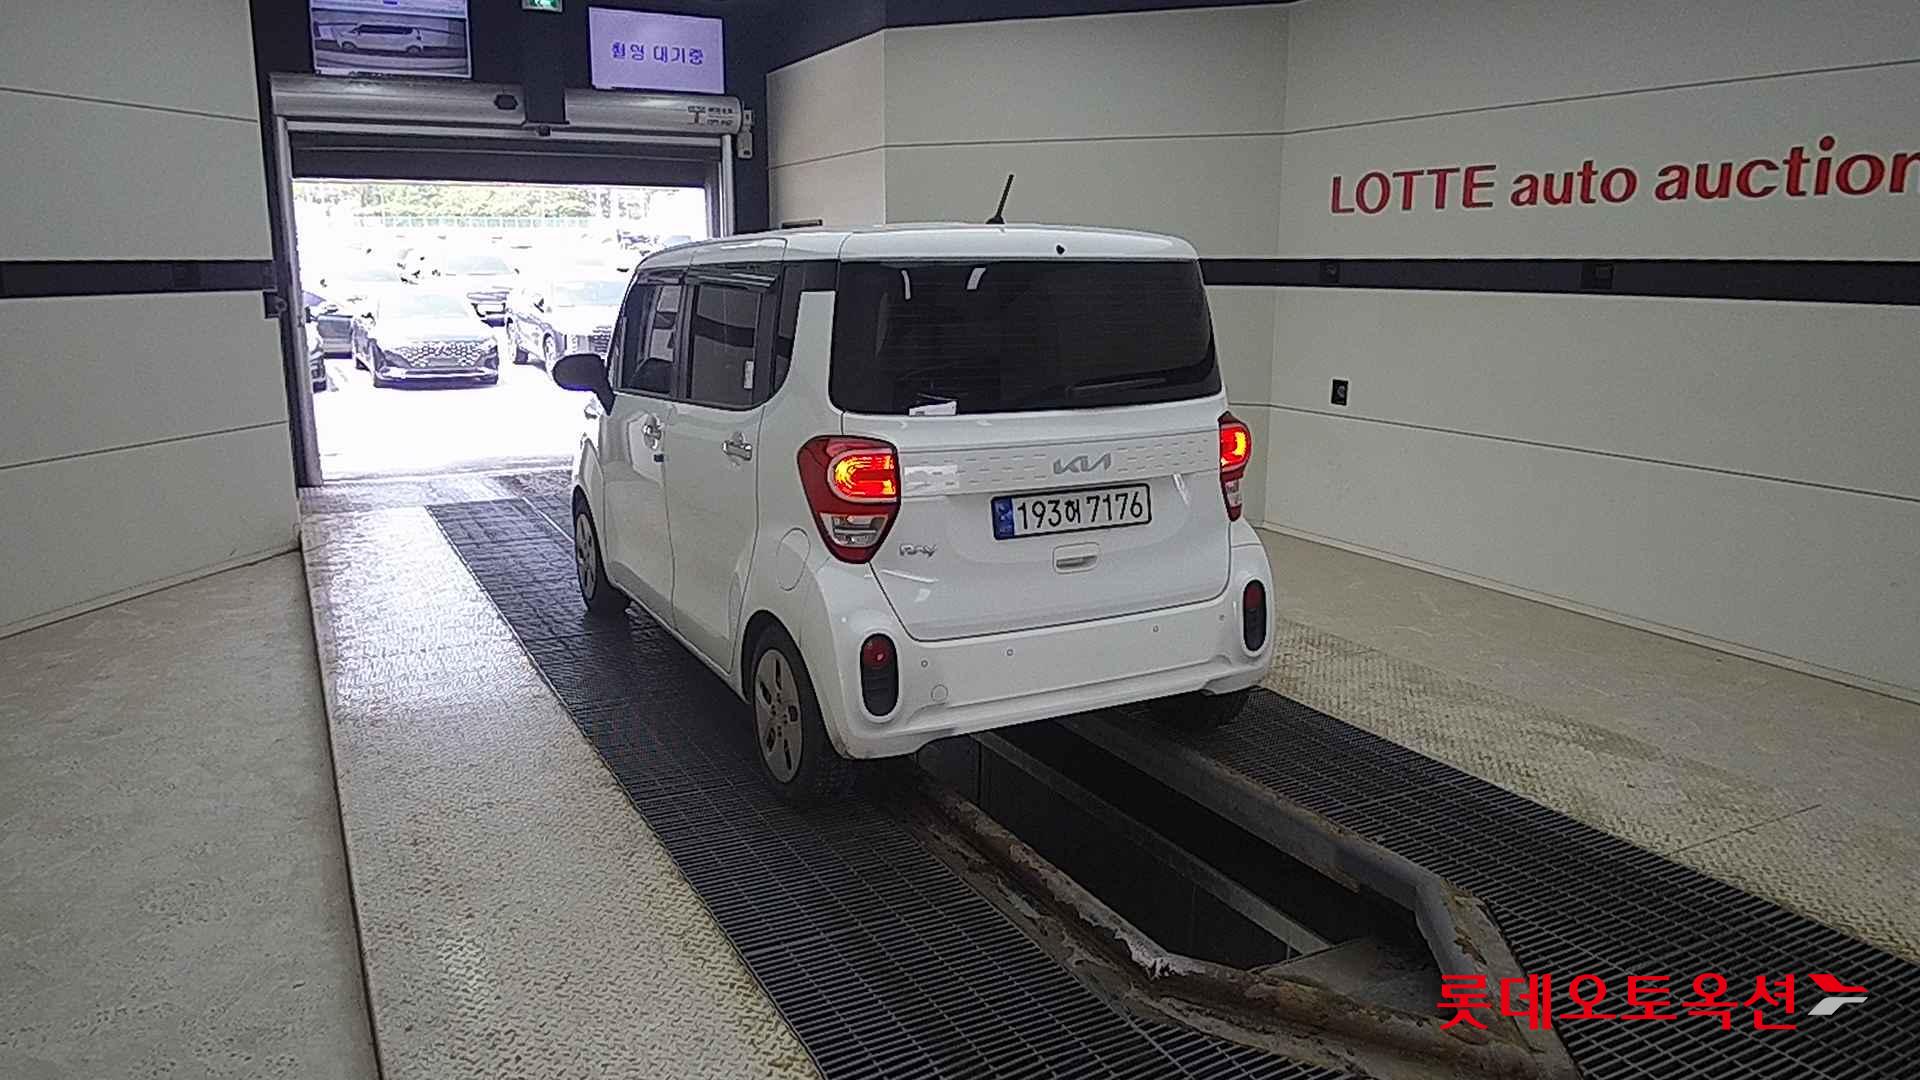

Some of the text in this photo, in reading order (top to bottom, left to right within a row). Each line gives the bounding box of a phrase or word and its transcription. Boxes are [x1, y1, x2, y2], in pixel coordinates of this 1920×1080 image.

[653, 45, 704, 65] 대기중
[1331, 164, 1496, 213] LOTTE
[1510, 160, 1638, 207] auto
